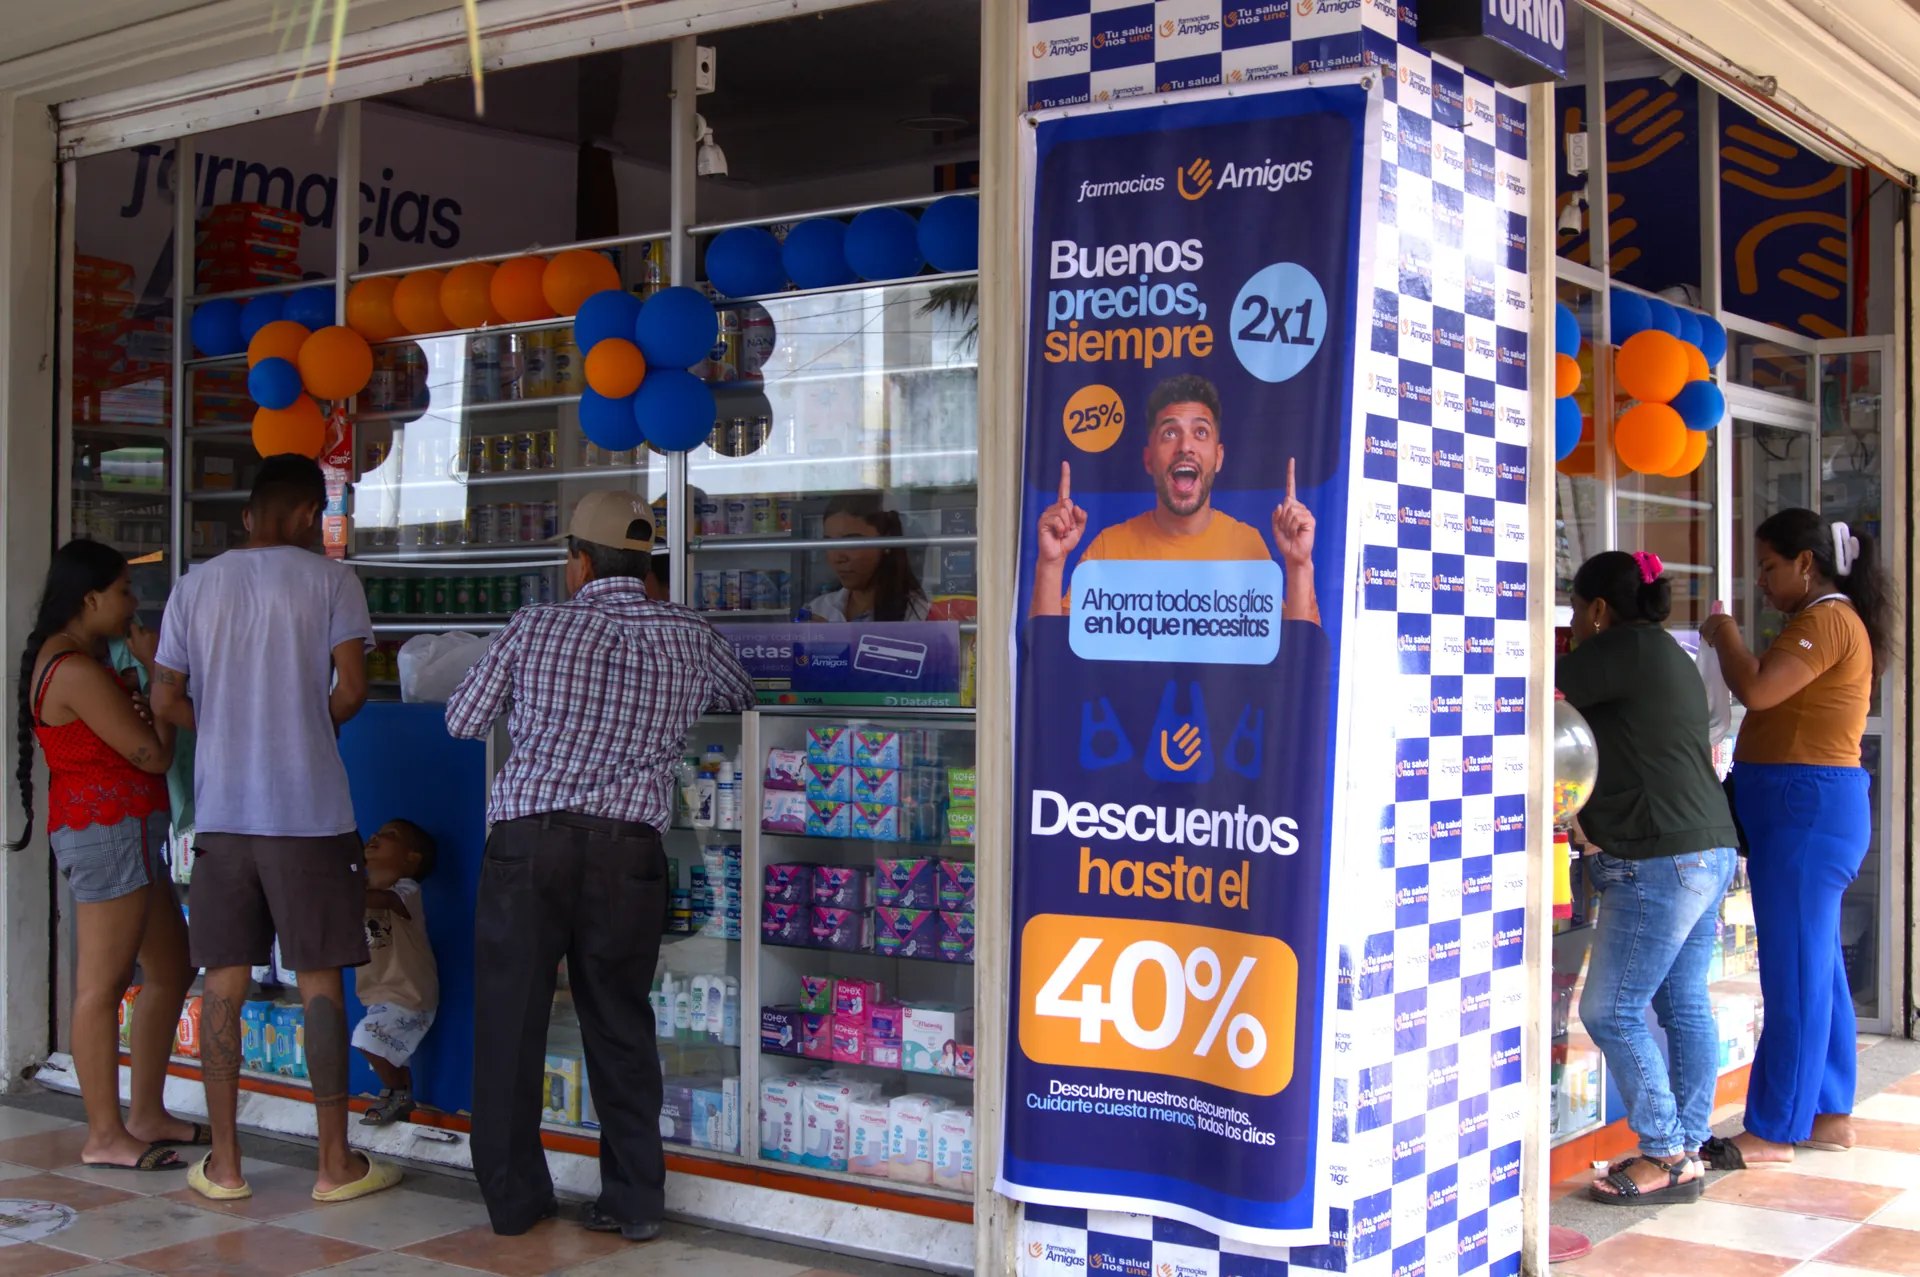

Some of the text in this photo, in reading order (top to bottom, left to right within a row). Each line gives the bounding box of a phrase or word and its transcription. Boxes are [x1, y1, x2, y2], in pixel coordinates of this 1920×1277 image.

[1238, 1, 1289, 18] Tu salud
[1178, 14, 1210, 26] farmacias
[1237, 12, 1289, 25] nos une.
[1105, 24, 1153, 39] Tu salud
[1178, 20, 1220, 35] Amigas
[1049, 36, 1080, 45] farmacias
[1105, 33, 1153, 47] nos une.
[1049, 42, 1088, 57] Amigas
[1309, 53, 1361, 69] Tu salud
[1245, 63, 1278, 74] farmacias
[1171, 74, 1220, 89] Tu salud
[1409, 78, 1431, 97] Amigas
[1112, 85, 1144, 96] farmacias
[1439, 83, 1463, 102] Tu salud
[1043, 93, 1088, 108] Tu salud
[1439, 94, 1450, 103] nos
[1474, 110, 1494, 123] Amigas
[1501, 114, 1525, 129] Tu salud
[1501, 122, 1512, 132] nos
[1077, 158, 1313, 202] farmacias Amigas
[1050, 238, 1204, 279] Buenos
[1047, 274, 1207, 330] precios,
[1238, 294, 1316, 346] 2x1
[1440, 329, 1464, 343] Tu salud
[1440, 338, 1451, 347] nos
[1044, 320, 1214, 368] siempre
[1502, 347, 1526, 361] Tu salud
[1502, 356, 1512, 365] nos
[1406, 382, 1432, 395] Tu salud
[1406, 391, 1418, 400] nos
[1068, 400, 1123, 435] 25%
[1371, 436, 1397, 450] Tu salud
[1371, 447, 1383, 455] nos
[329, 454, 348, 465] Claro
[1405, 507, 1431, 519] Tu salud
[1405, 517, 1417, 525] nos
[1371, 567, 1397, 578] Tu salud
[1371, 577, 1383, 585] nos
[1502, 581, 1526, 591] Tu salud
[1502, 589, 1513, 597] nos
[1081, 588, 1273, 614] Ahorra todos los días
[1084, 612, 1270, 640] en lo que necesitas
[1471, 637, 1494, 646] Tu salud
[735, 644, 792, 661] jetas
[811, 657, 848, 669] Amigas
[900, 696, 950, 706] Datafast
[1403, 758, 1429, 768] Tu salud
[1402, 768, 1414, 776] nos
[1030, 789, 1300, 856] Descuentos
[1500, 814, 1524, 823] Tu salud
[1500, 823, 1511, 831] nos
[1078, 846, 1250, 910] hasta el
[1035, 936, 1268, 1069] 40%
[1050, 1079, 1252, 1126] Descubre nuestros descuentos.
[1026, 1093, 1275, 1146] Cuidarte cuesta menos, todos los días
[1046, 1242, 1076, 1254] farmacias
[1045, 1251, 1085, 1267] Amigas
[1102, 1252, 1150, 1269] Tu salud
[1102, 1262, 1151, 1276] nos une.
[1174, 1264, 1208, 1276] farmacias
